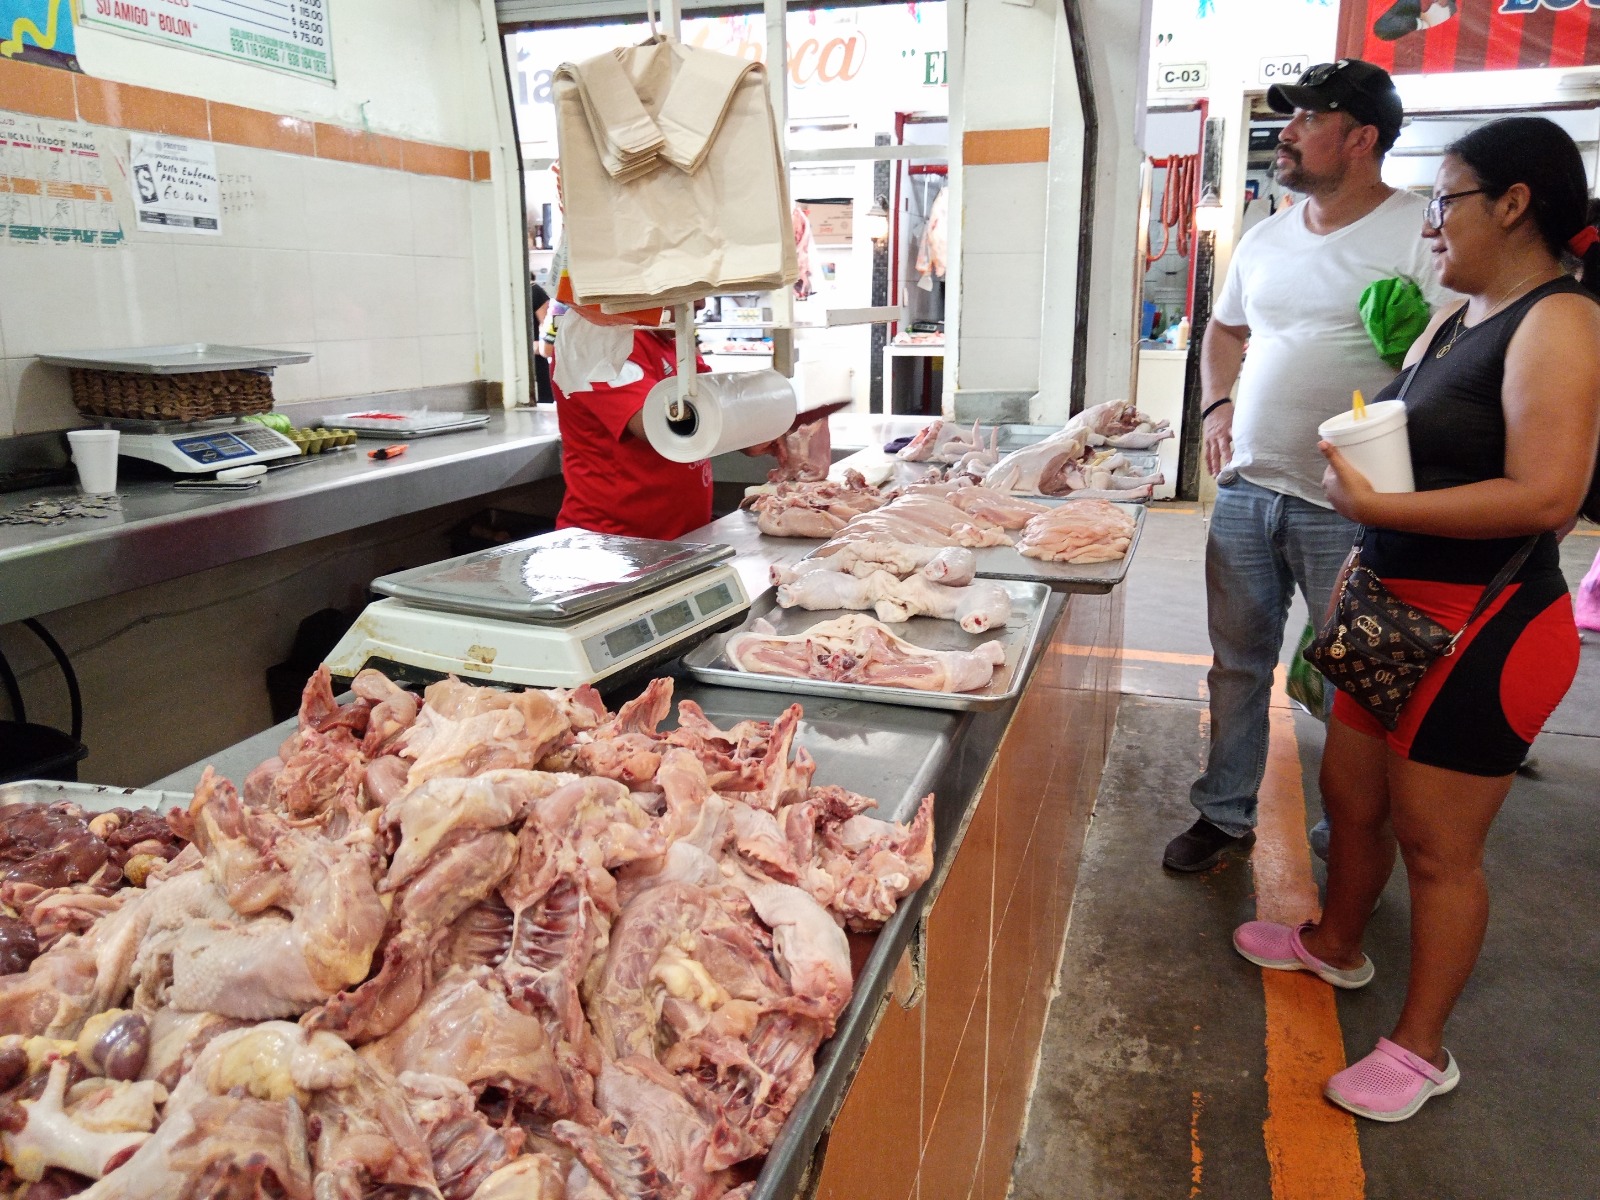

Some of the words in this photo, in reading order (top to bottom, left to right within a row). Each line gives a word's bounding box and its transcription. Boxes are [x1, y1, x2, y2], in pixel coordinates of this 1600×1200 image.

[96, 0, 111, 16] SU
[114, 1, 148, 26] AMIGO
[291, 4, 296, 12] $
[300, 7, 323, 21] 115.00
[292, 17, 297, 26] $
[299, 20, 323, 33] 65.00
[293, 30, 298, 39] $
[300, 32, 324, 46] 75.00
[1164, 70, 1201, 83] C-03
[1264, 62, 1302, 77] C-04
